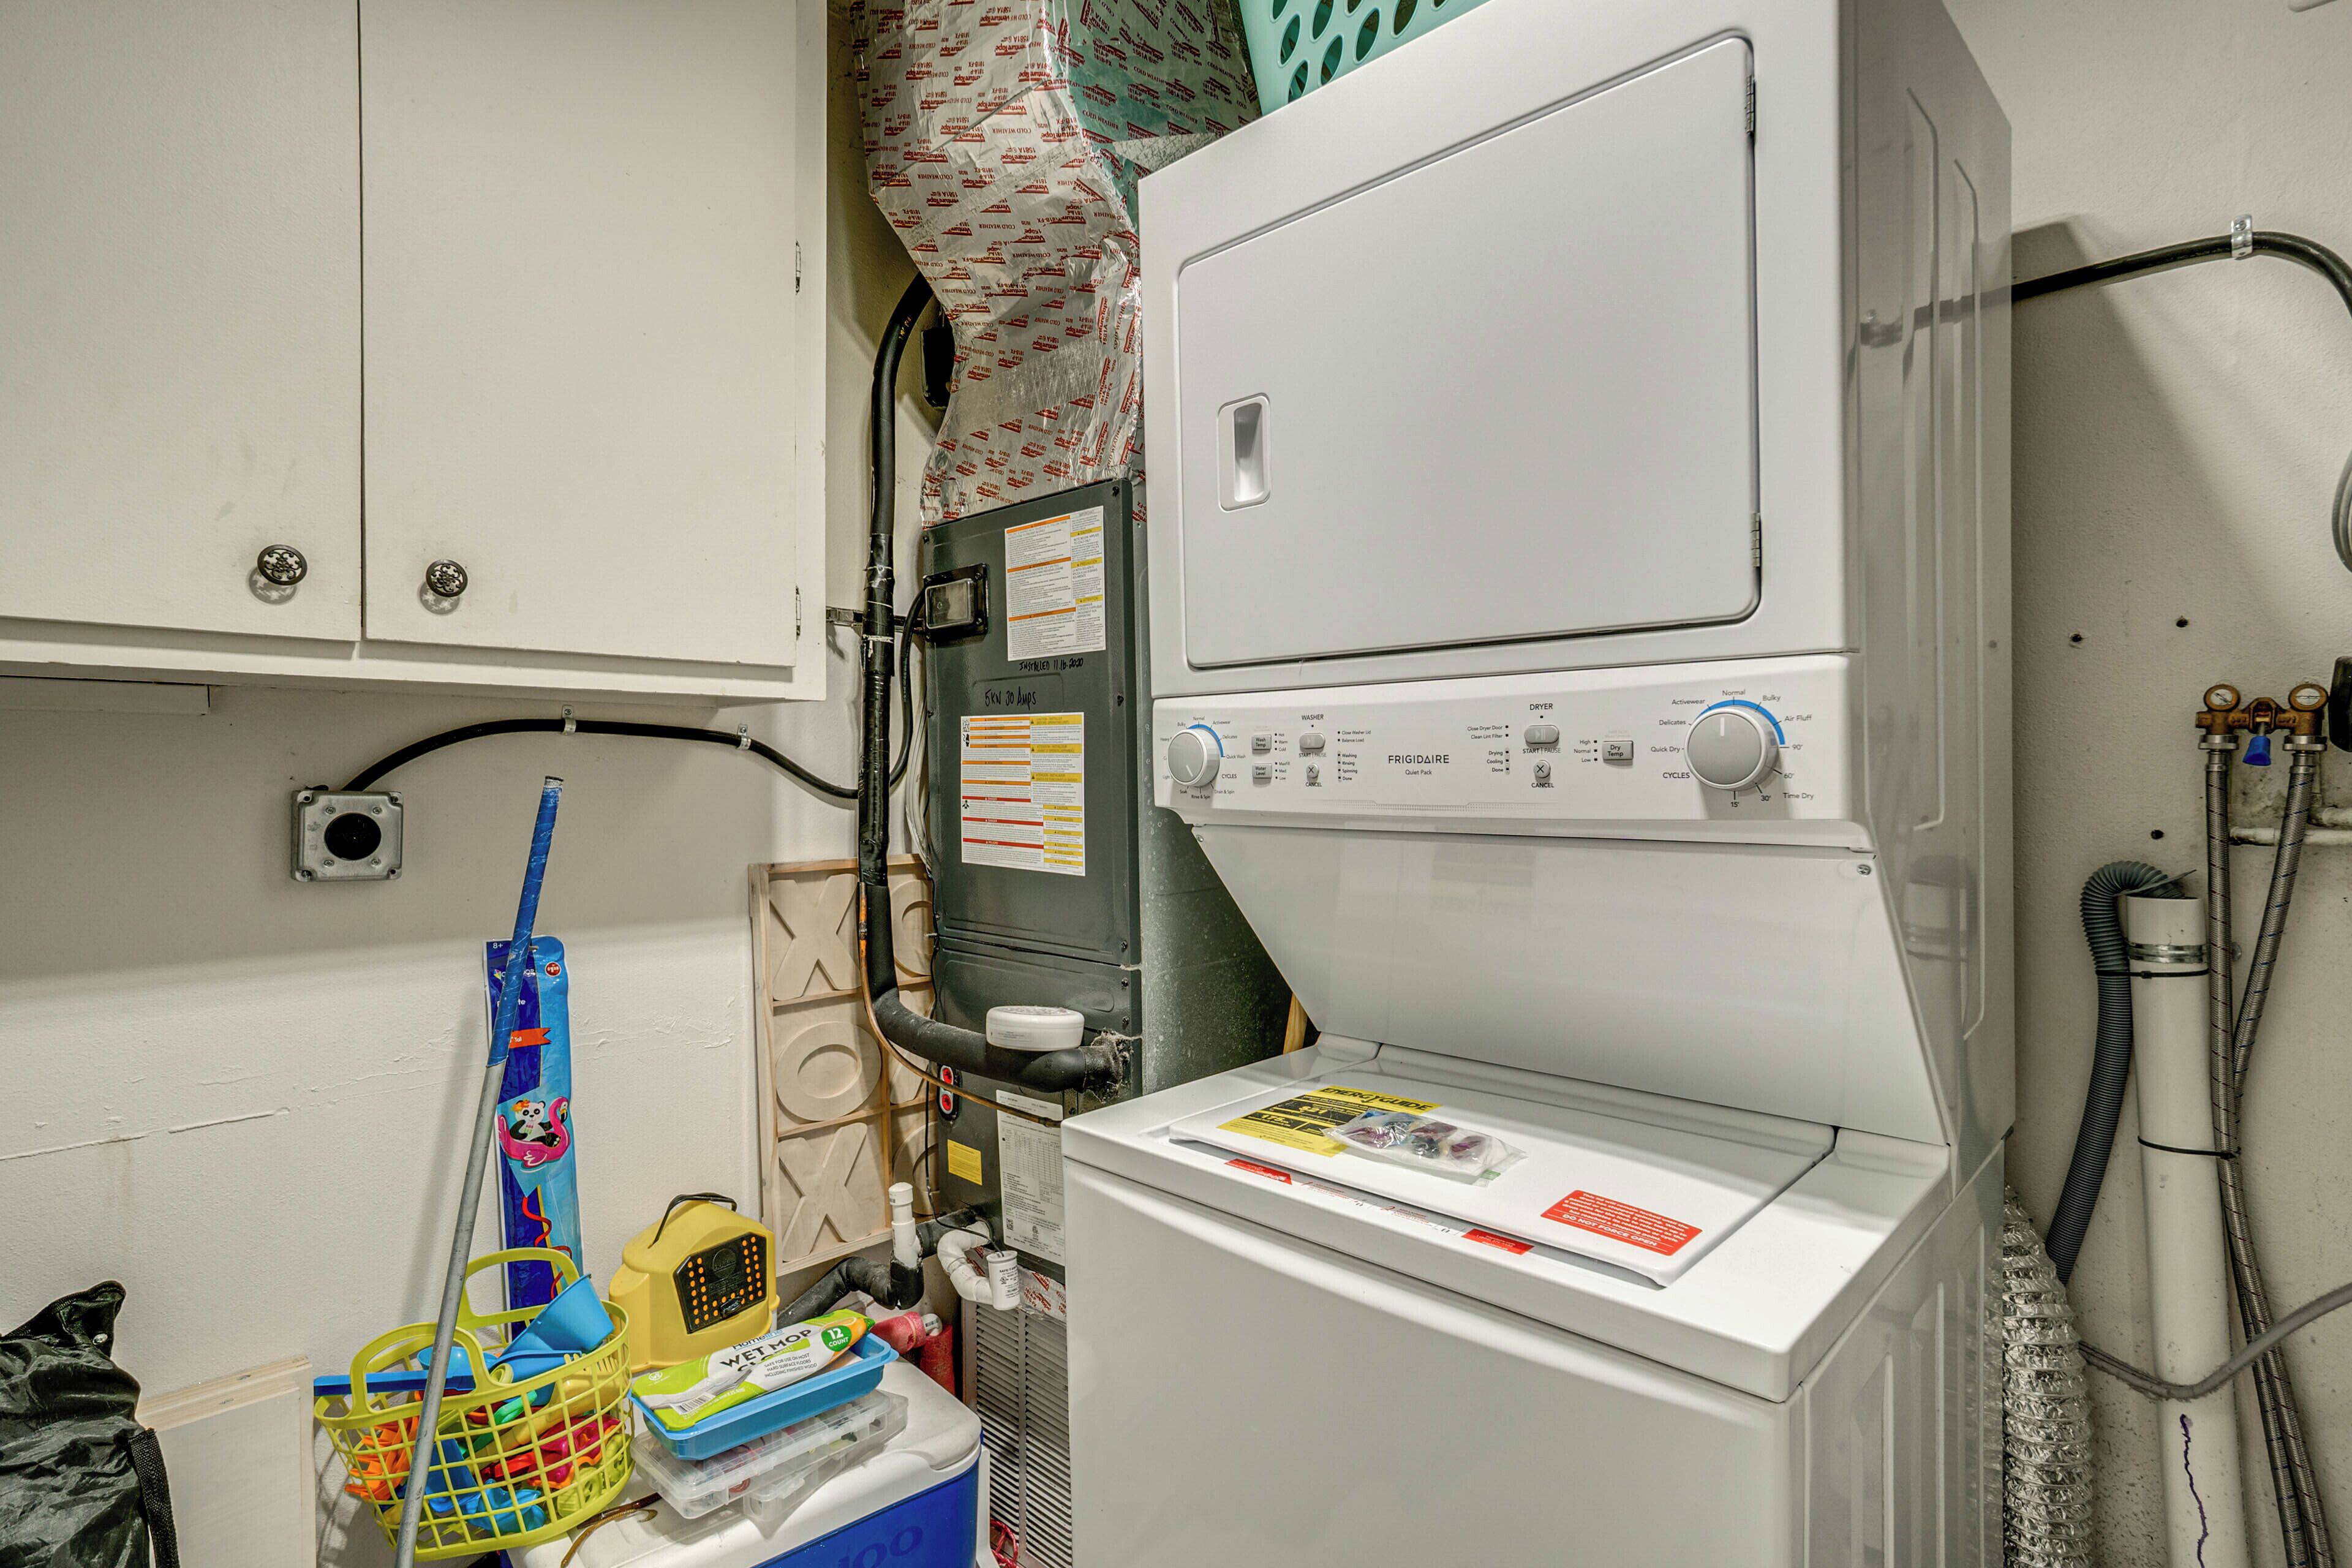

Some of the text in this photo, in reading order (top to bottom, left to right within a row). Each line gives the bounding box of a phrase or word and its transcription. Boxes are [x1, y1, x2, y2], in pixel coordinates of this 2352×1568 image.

[1083, 110, 1119, 130] COLD WEATHER
[1019, 661, 1049, 671] INSTALLED
[1006, 690, 1014, 706] 30
[1389, 755, 1450, 764] FRIGIDAIRE
[1321, 1088, 1432, 1111] ENERGYGUIDE
[1598, 1225, 1630, 1237] FORCE
[1630, 1235, 1657, 1246] OPEN
[827, 1328, 843, 1339] 12
[720, 1346, 764, 1368] WET
[769, 1329, 812, 1351] MOP
[829, 1337, 848, 1347] COUNT
[764, 1369, 786, 1378] INCLUDING
